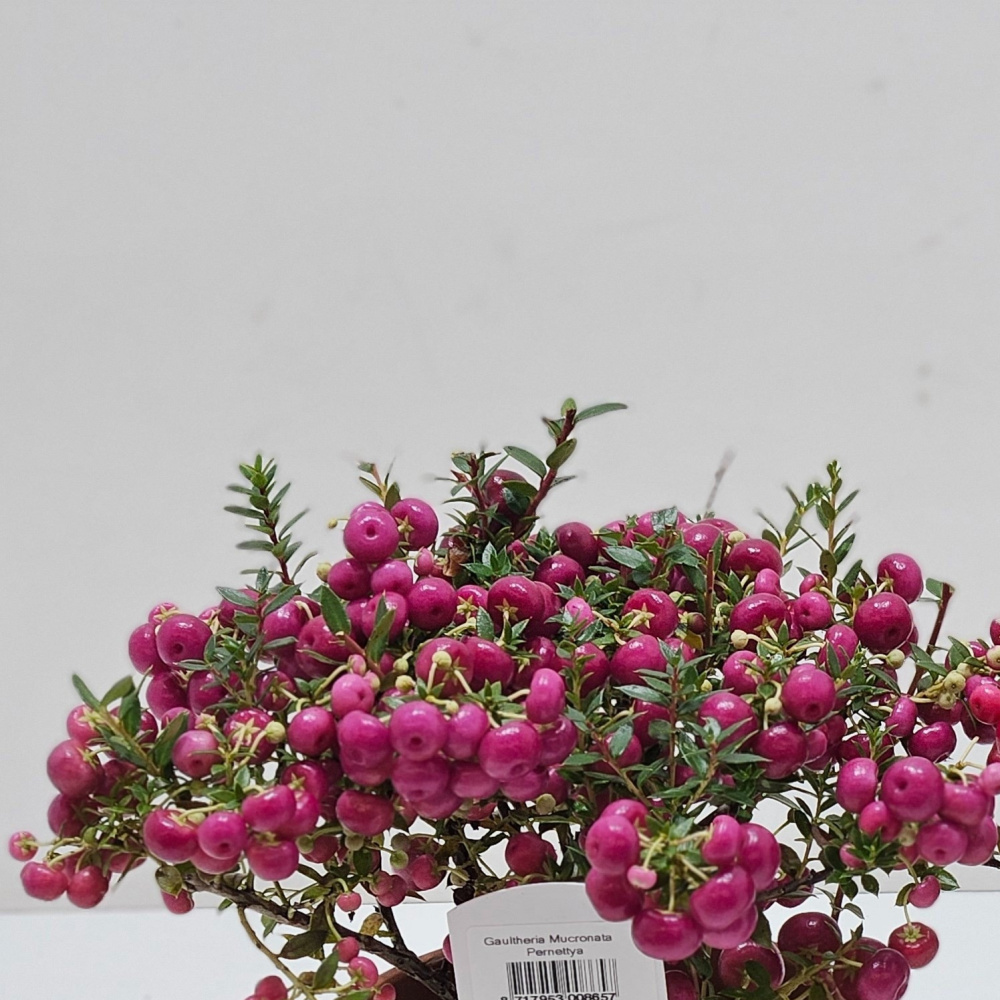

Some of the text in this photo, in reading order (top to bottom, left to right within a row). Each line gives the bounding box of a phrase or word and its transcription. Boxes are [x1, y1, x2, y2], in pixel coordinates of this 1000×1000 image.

[484, 934, 612, 946] Gaultheria Mucronata
[527, 948, 583, 957] Pernettya
